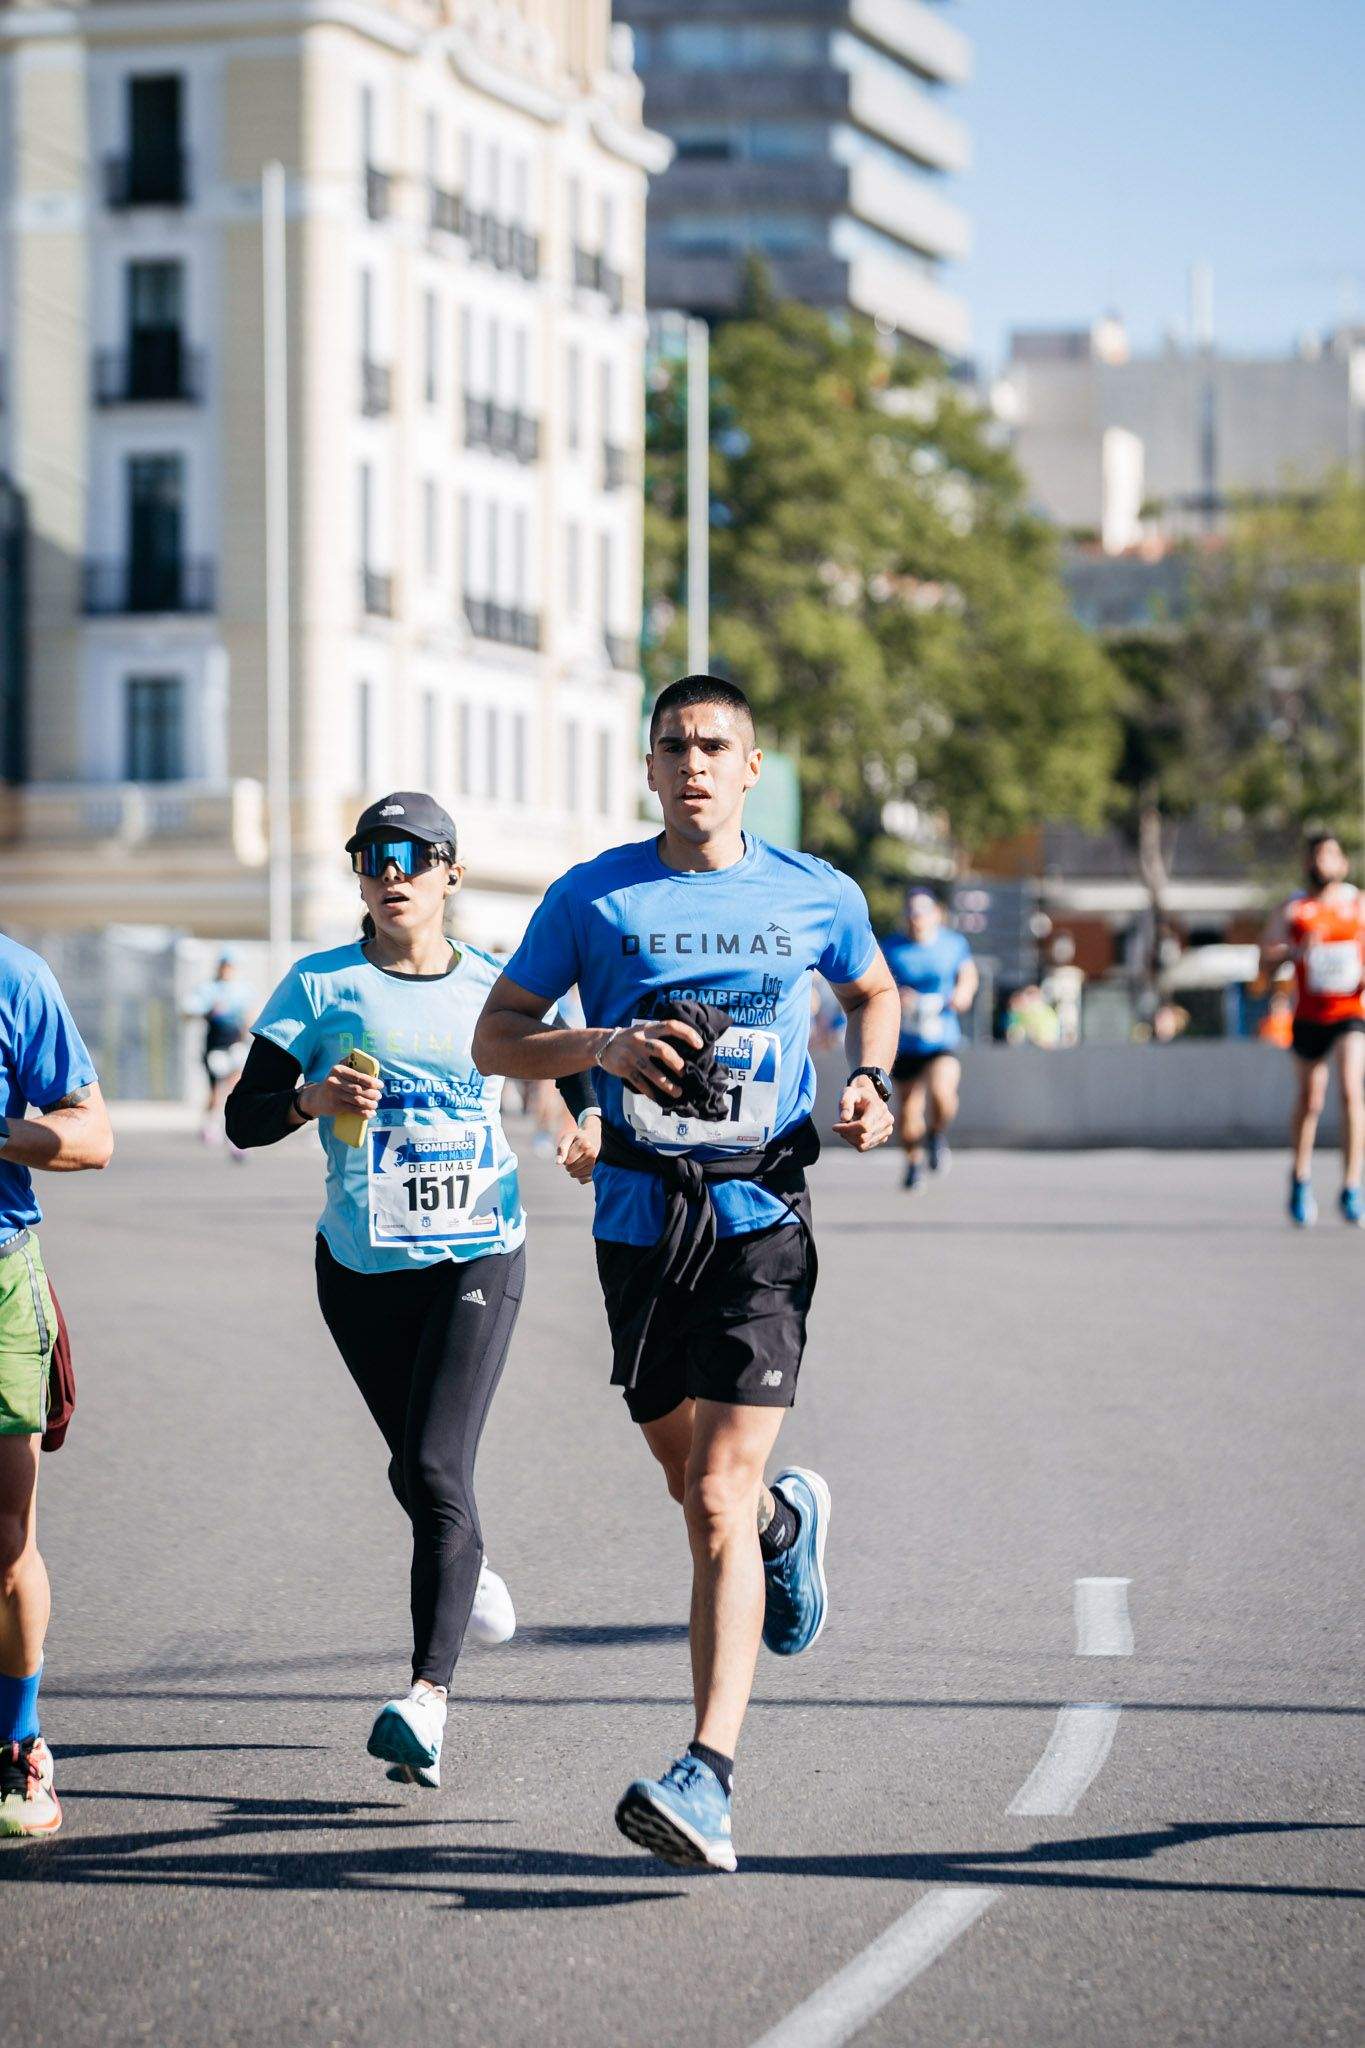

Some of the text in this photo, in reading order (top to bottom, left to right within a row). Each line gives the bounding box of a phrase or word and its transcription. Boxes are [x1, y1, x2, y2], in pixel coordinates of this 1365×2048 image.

[621, 934, 792, 957] DECIMAS
[669, 989, 776, 1009] BOMBEROS
[339, 1032, 455, 1053] DECIM
[390, 1079, 481, 1098] BOMBEROS
[428, 1092, 442, 1107] de
[415, 1140, 475, 1153] BOMBEROS
[439, 1151, 448, 1160] de
[408, 1160, 474, 1174] DECIMAS
[402, 1174, 470, 1212] 1517
